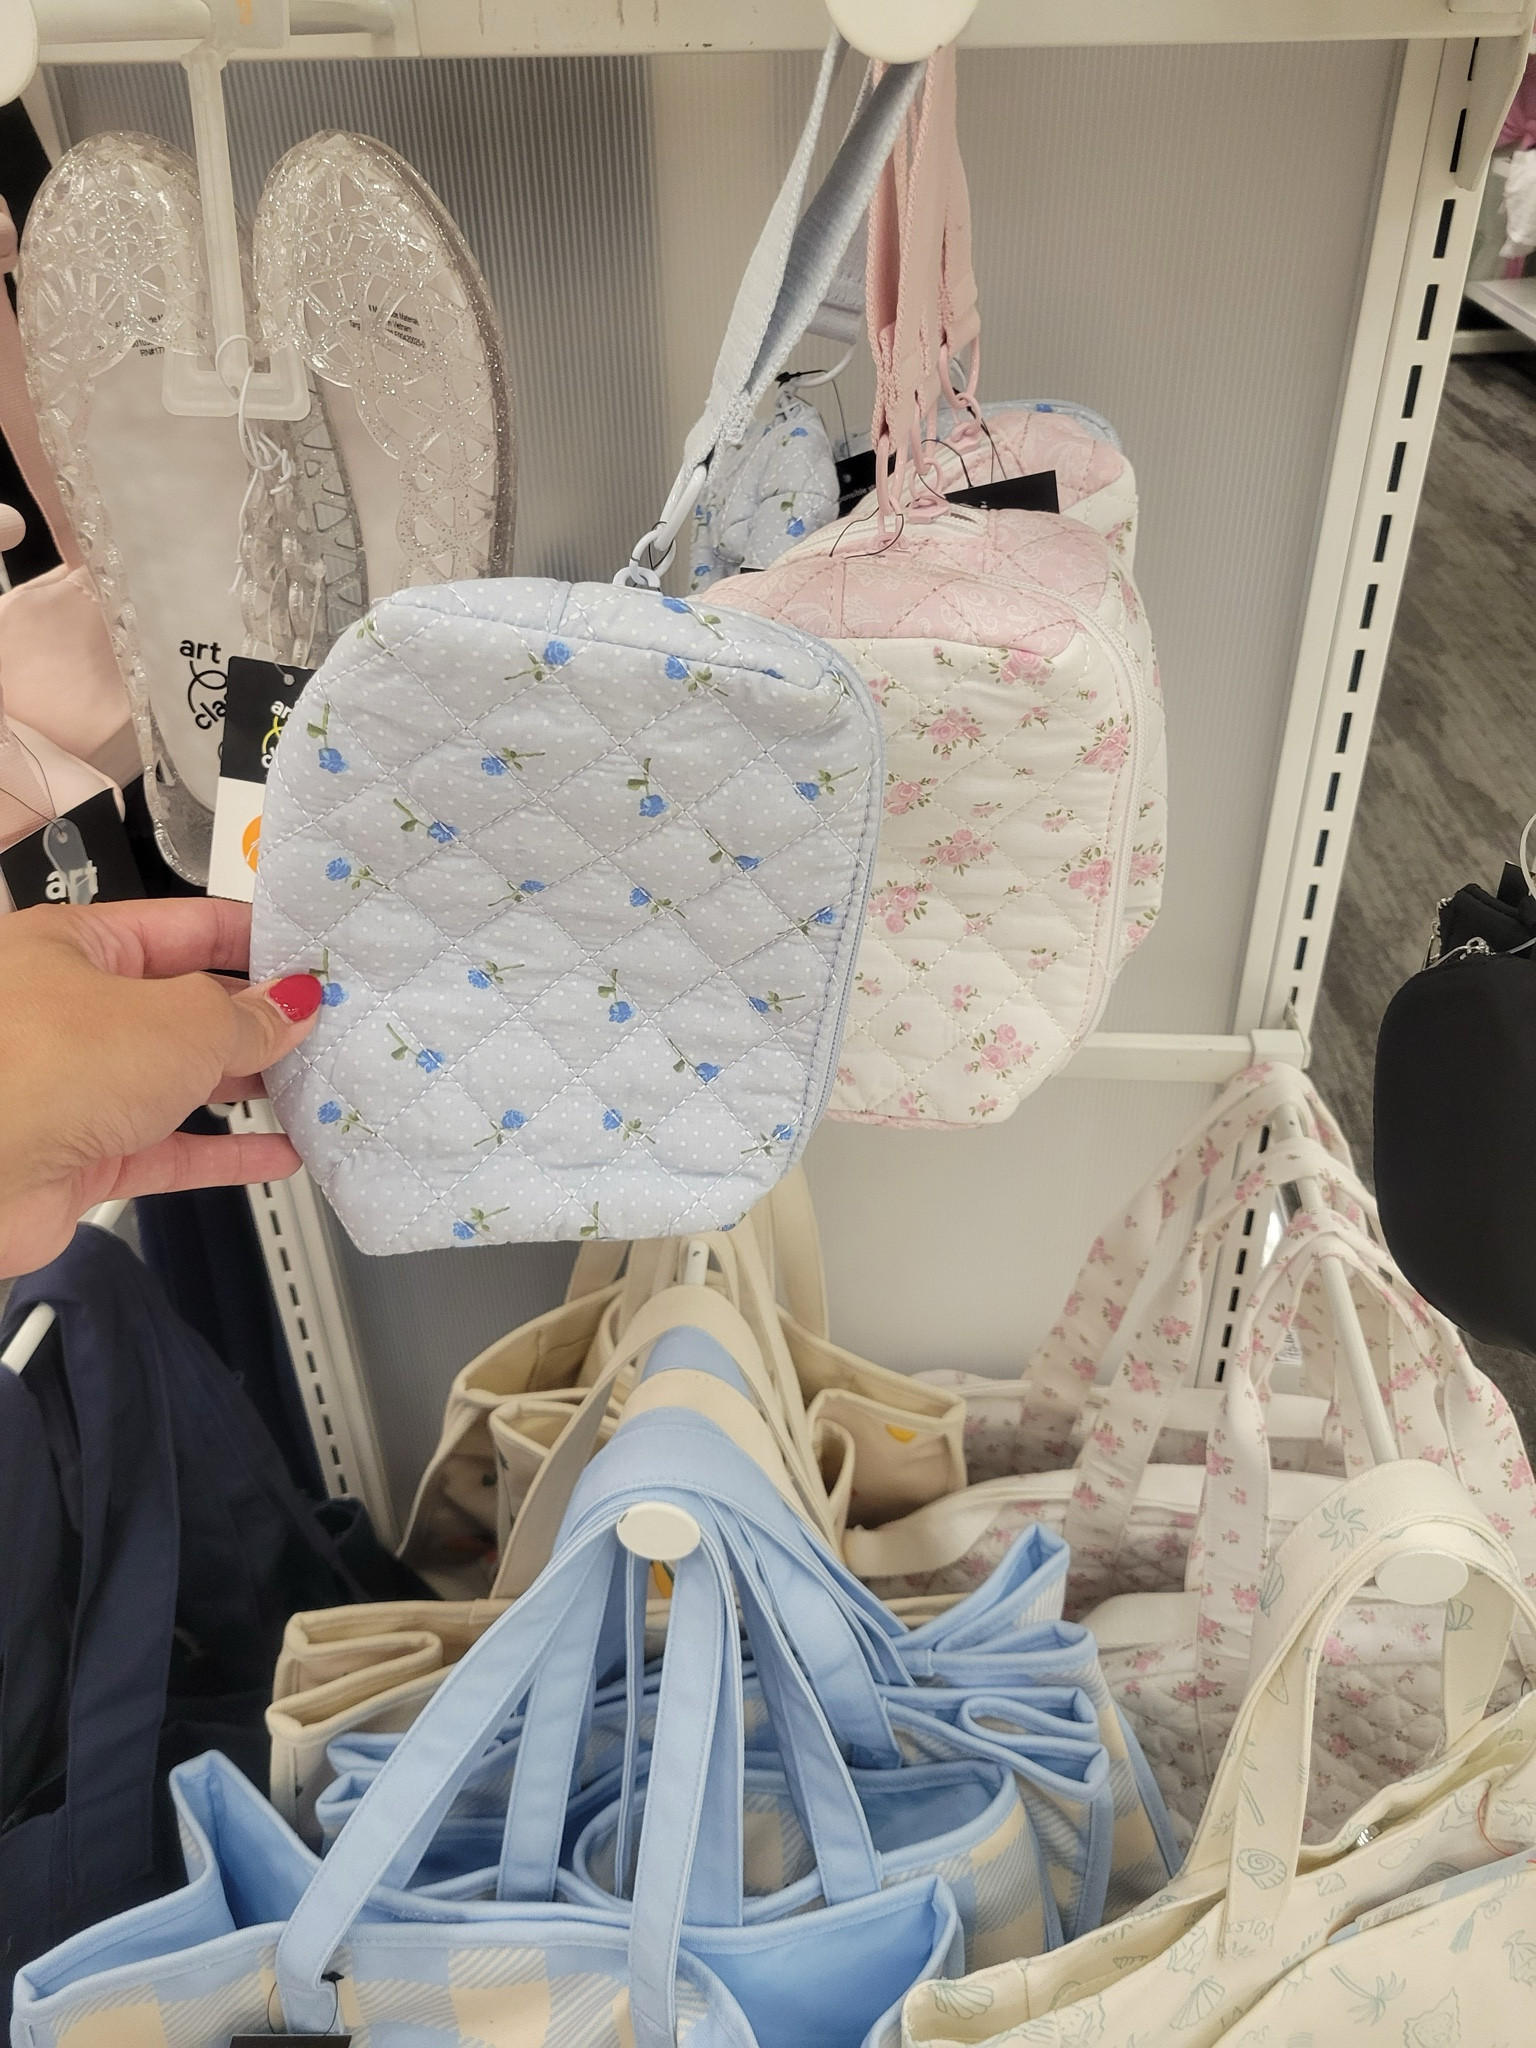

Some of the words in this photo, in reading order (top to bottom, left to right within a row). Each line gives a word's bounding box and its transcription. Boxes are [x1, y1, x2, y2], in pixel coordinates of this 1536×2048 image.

[179, 639, 222, 665] art
[195, 692, 227, 731] cla
[271, 700, 294, 719] ar
[45, 861, 99, 901] art
